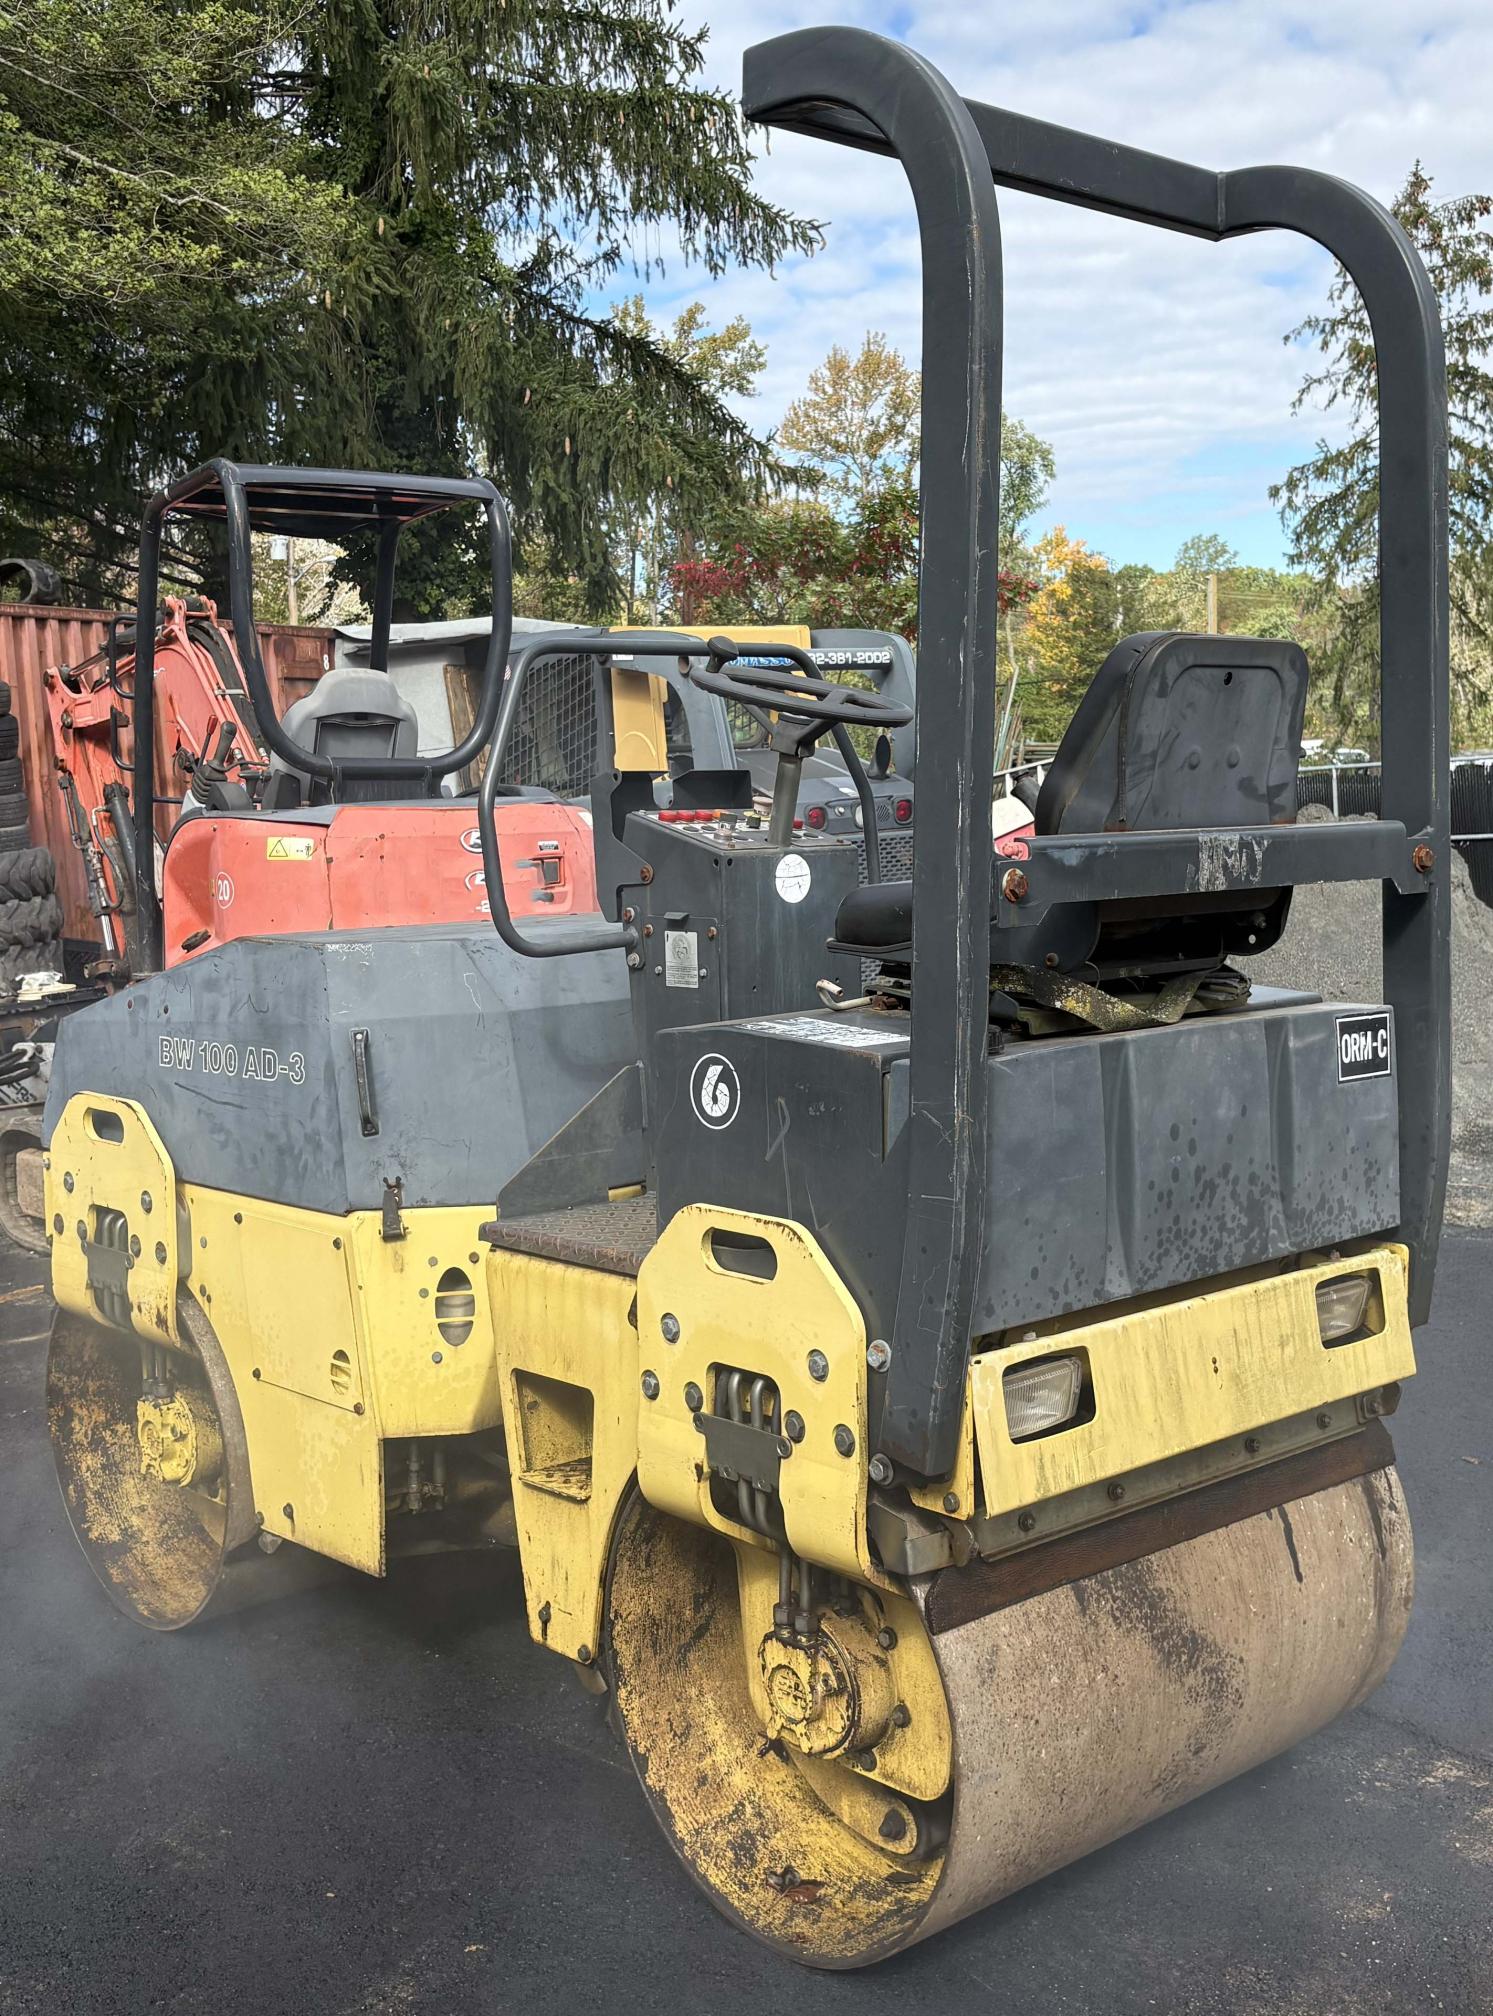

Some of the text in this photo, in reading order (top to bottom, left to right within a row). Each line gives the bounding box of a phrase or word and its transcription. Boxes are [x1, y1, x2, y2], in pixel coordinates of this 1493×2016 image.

[323, 654, 330, 670] 8
[218, 880, 230, 901] 20
[159, 1036, 306, 1084] BW 100 AD-3
[1341, 1028, 1387, 1064] ORM-C
[701, 1065, 730, 1117] 6
